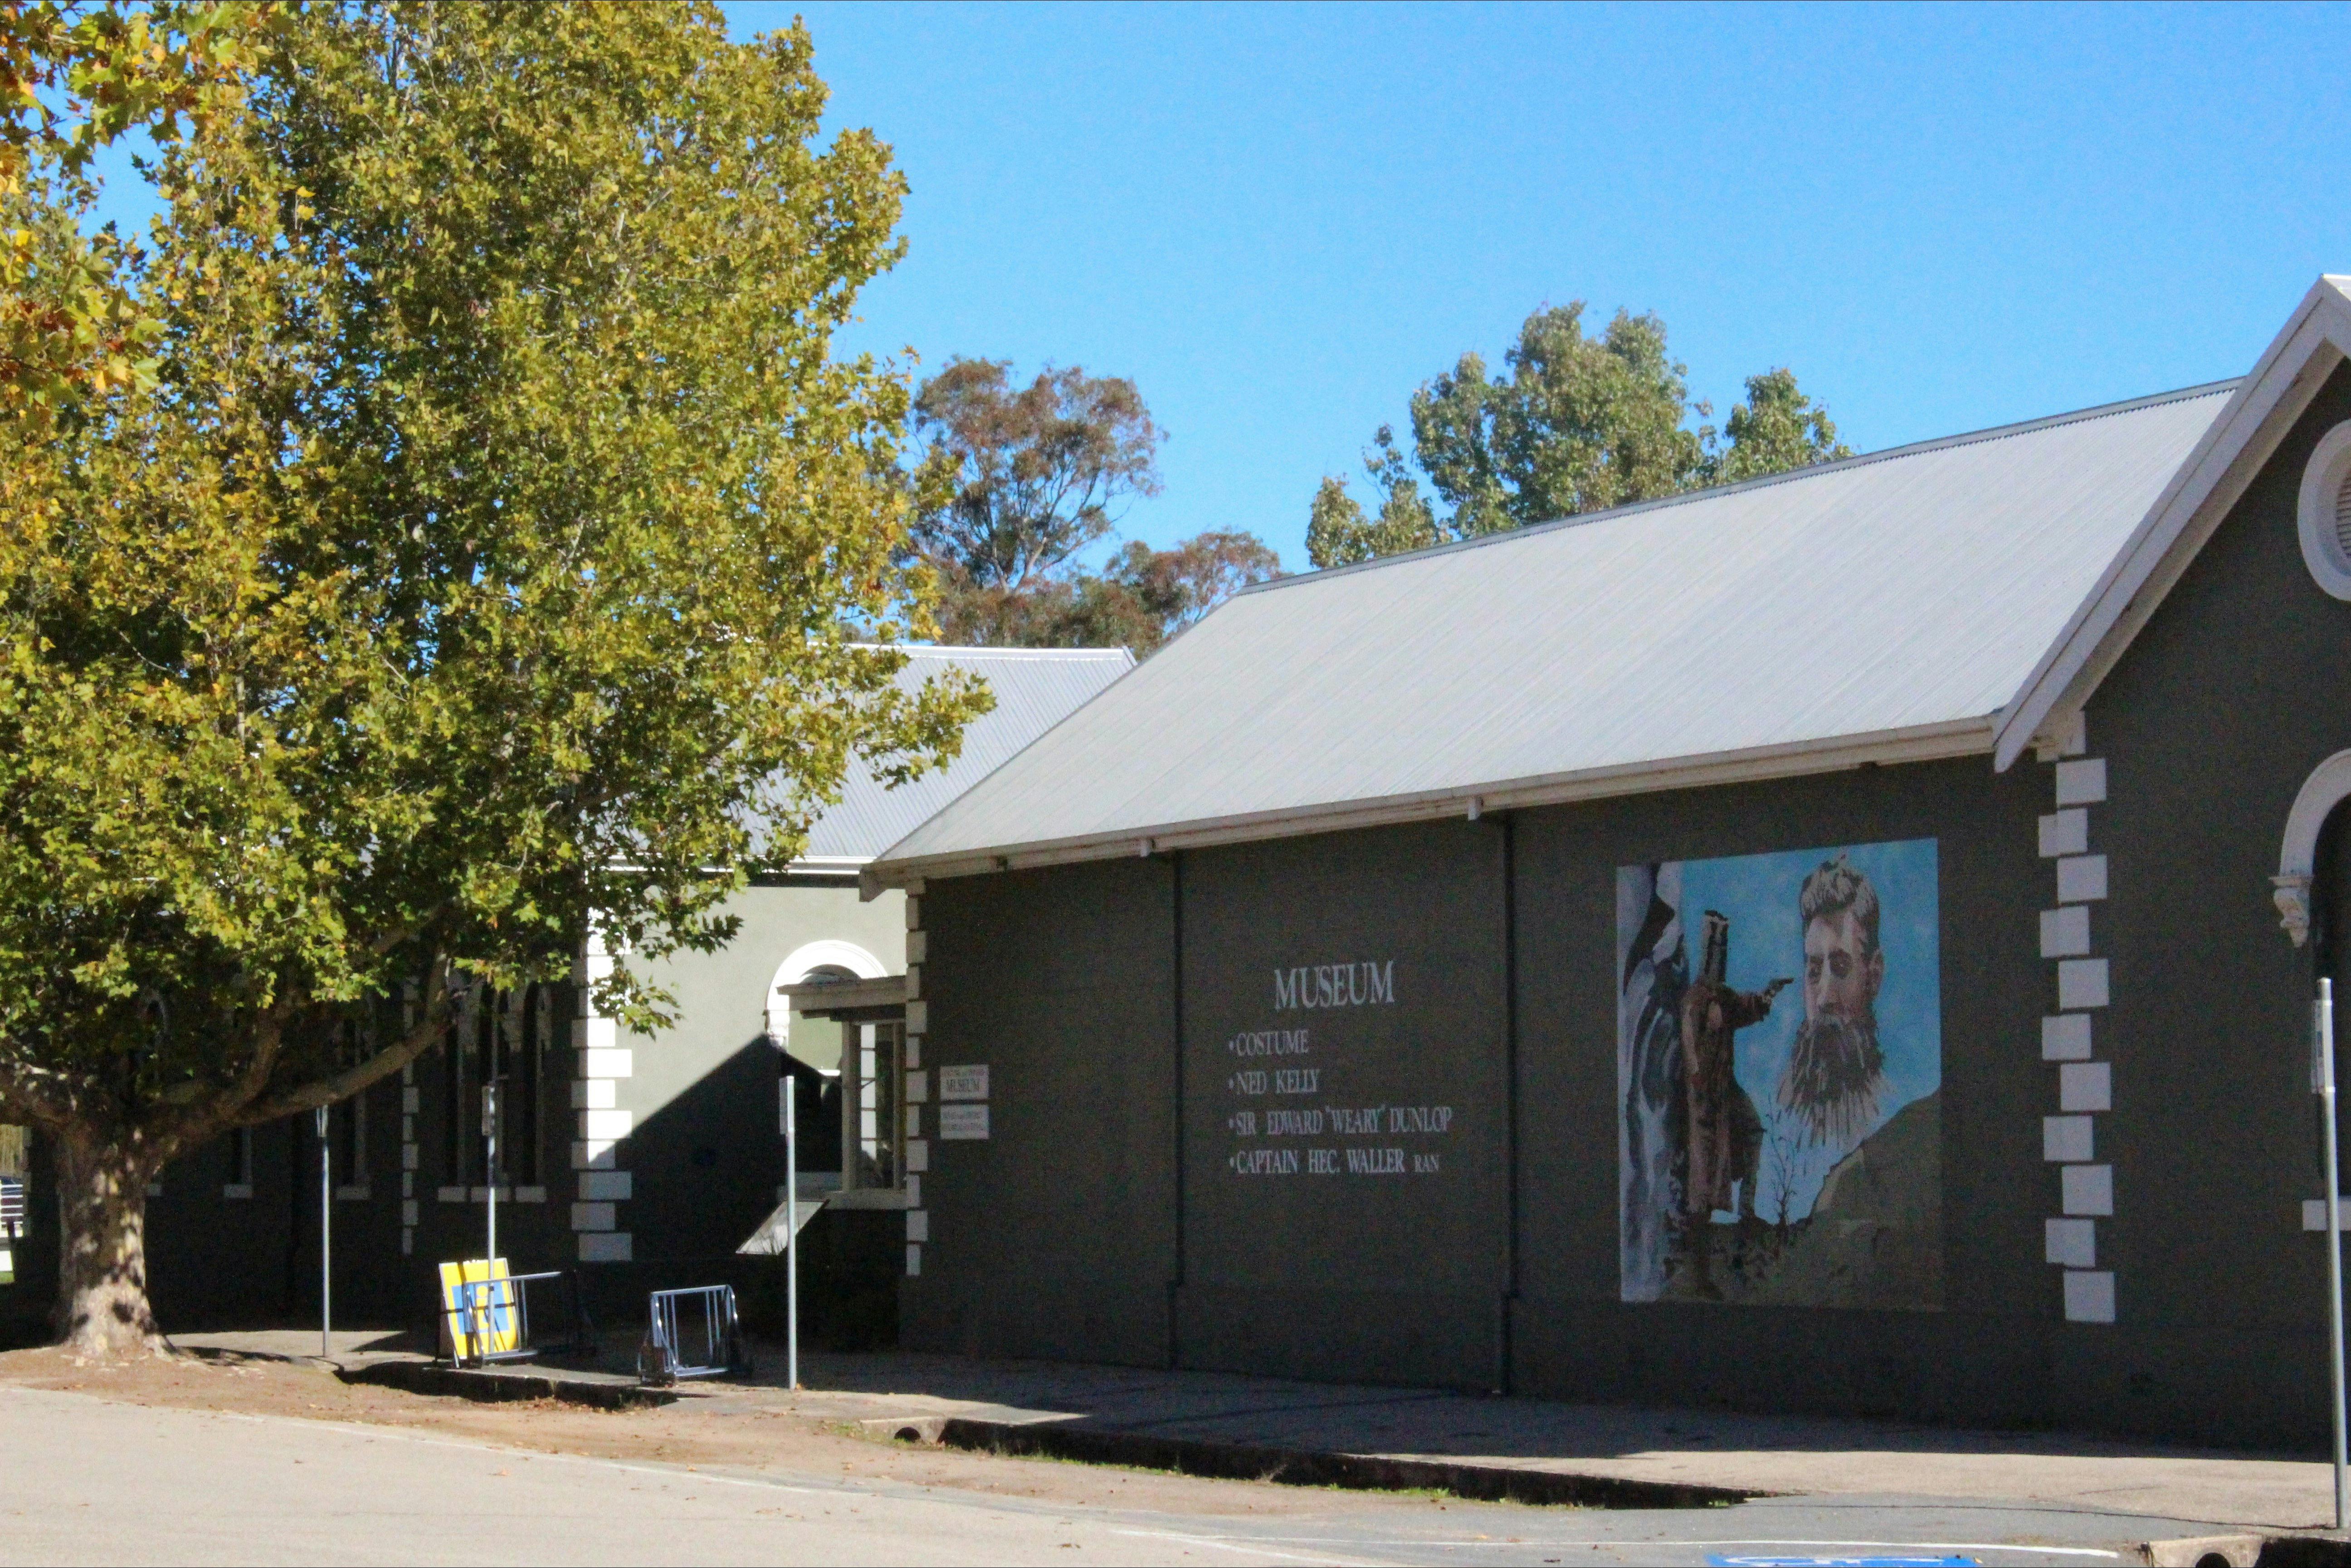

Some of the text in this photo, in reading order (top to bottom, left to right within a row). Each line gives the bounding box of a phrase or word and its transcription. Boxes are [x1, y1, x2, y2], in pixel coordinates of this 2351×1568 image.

[1274, 960, 1395, 1010] MUSEUM
[1236, 1029, 1309, 1057] COSTUME
[1236, 1069, 1320, 1095] NED KELLY
[1236, 1111, 1257, 1135] SIR
[1266, 1109, 1322, 1135] EDWARD
[1390, 1106, 1453, 1133] DUNLOP
[1236, 1149, 1298, 1174] CAPTAIN
[1346, 1148, 1405, 1174] WALLER
[1415, 1154, 1439, 1173] RAN
